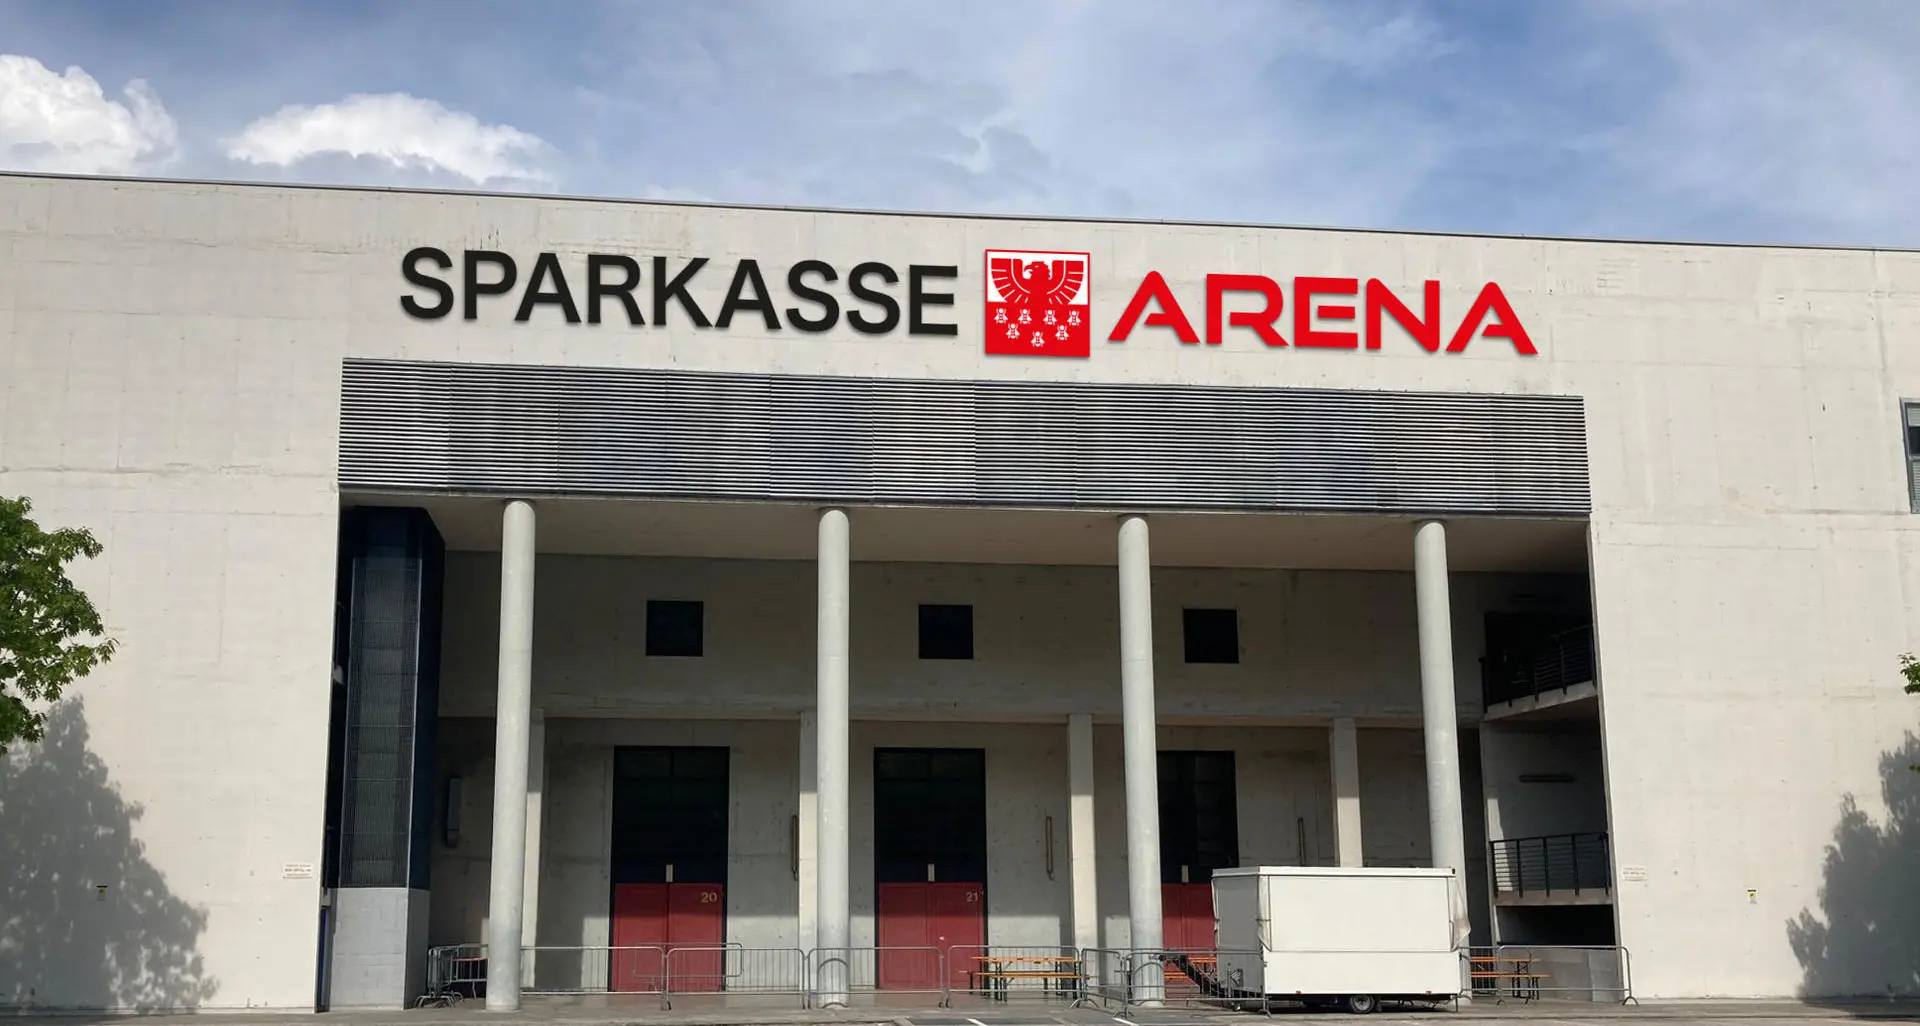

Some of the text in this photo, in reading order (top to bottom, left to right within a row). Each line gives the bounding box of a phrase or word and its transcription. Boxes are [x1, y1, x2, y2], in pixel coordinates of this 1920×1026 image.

[400, 247, 1539, 355] SPARKASSE ARENA
[701, 892, 718, 903] 20
[966, 891, 979, 903] 21
